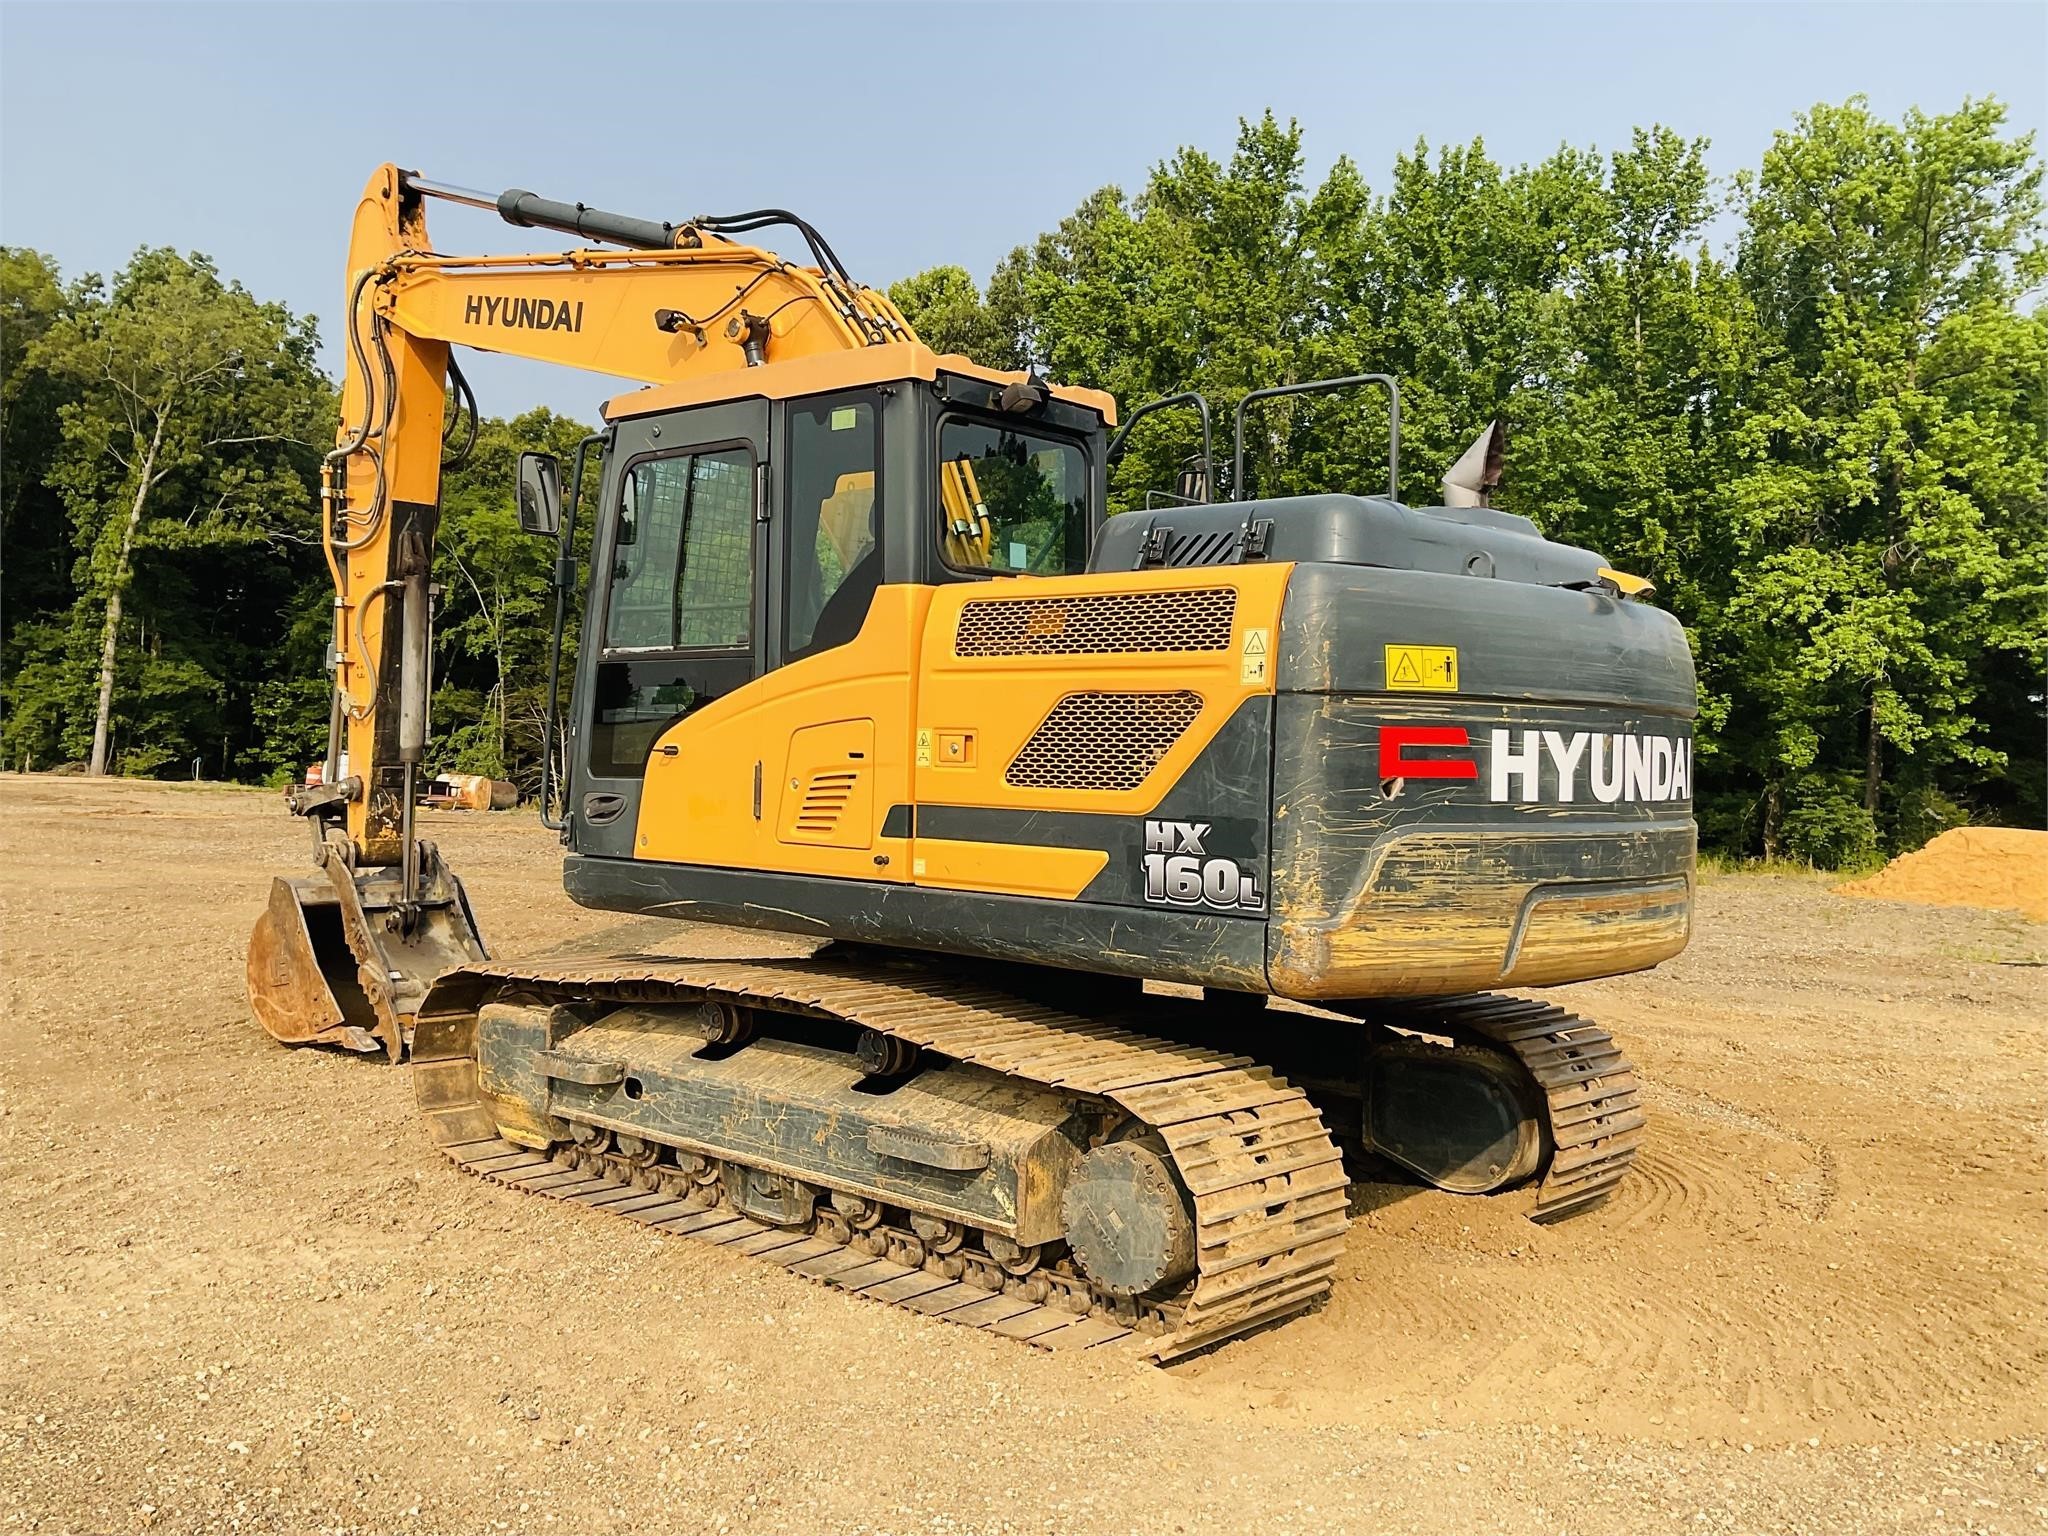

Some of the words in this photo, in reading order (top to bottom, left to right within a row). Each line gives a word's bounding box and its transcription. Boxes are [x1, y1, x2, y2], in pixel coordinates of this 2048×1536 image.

[464, 294, 584, 333] HYUNDAI
[1490, 728, 1692, 803] HYUNDAI
[1145, 820, 1212, 855] HX
[1143, 853, 1262, 906] 160L
